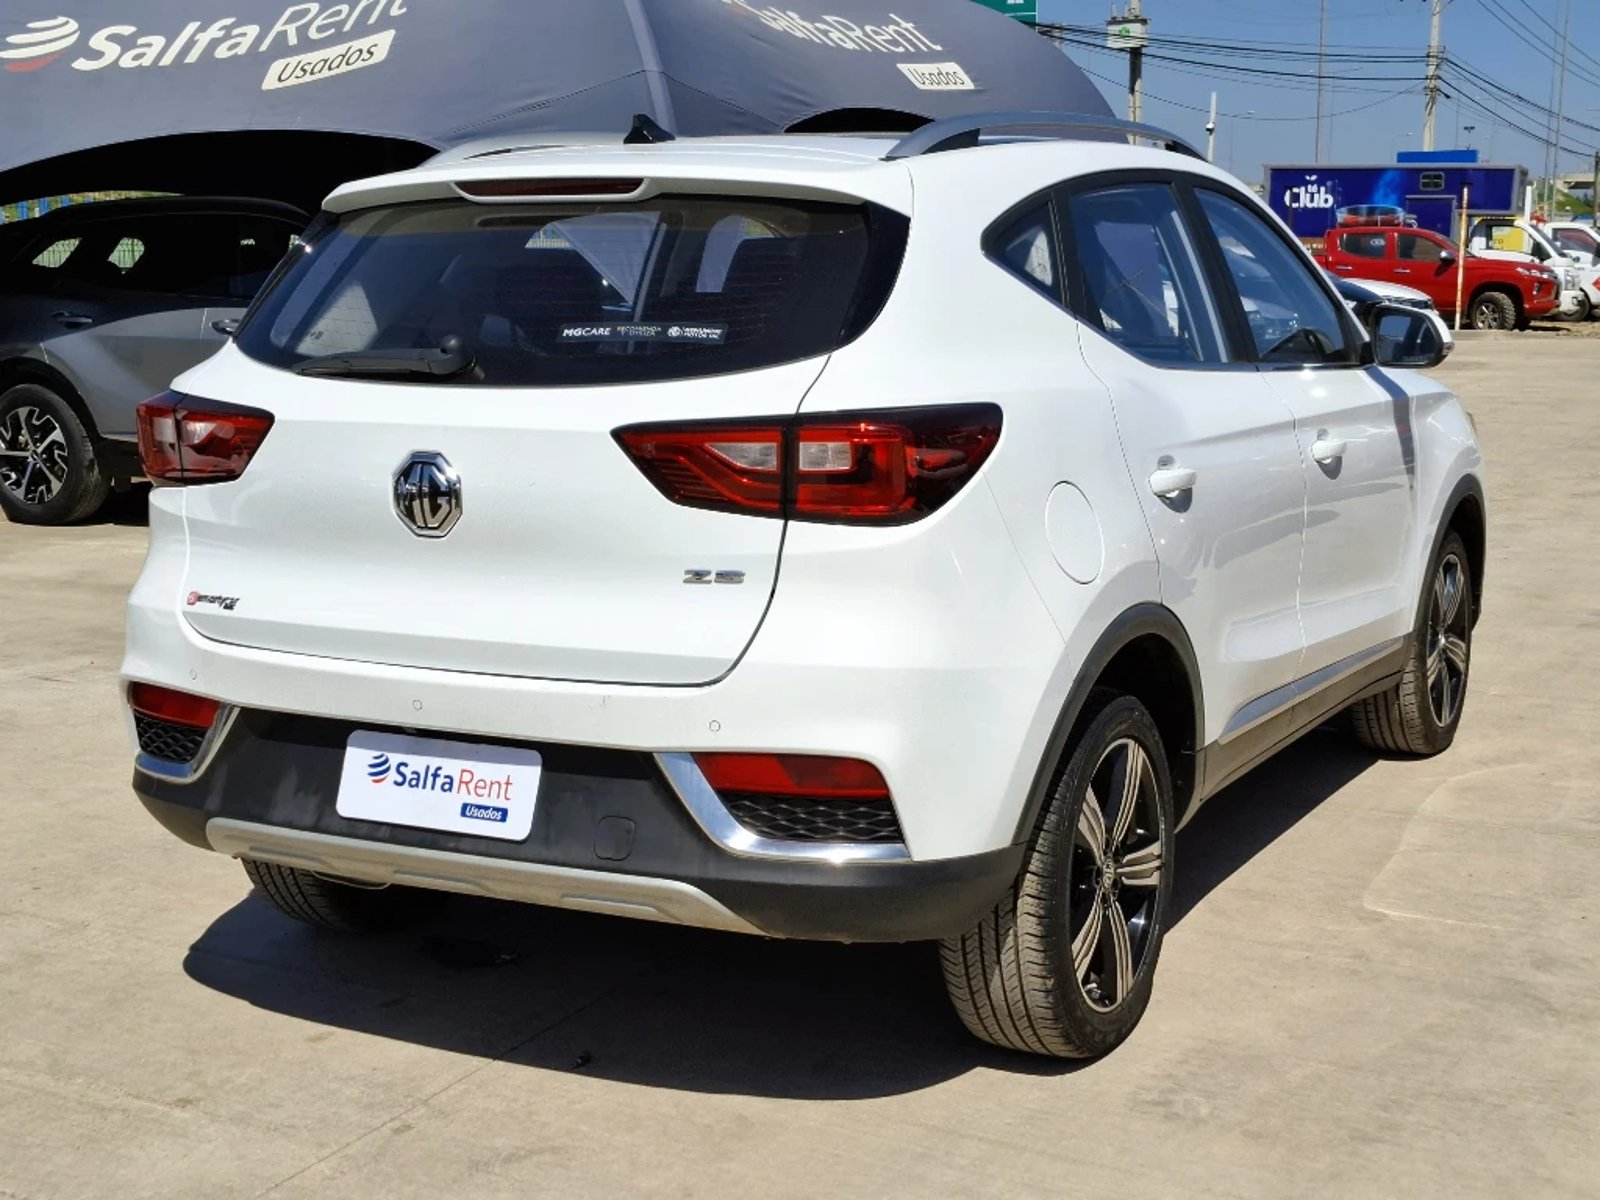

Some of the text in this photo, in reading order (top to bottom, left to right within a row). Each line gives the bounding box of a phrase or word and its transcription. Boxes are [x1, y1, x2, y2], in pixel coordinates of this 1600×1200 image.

[277, 42, 378, 83] Usados
[907, 66, 965, 86] Usados
[393, 761, 513, 801] SalfaRent
[465, 804, 503, 821] Usados
